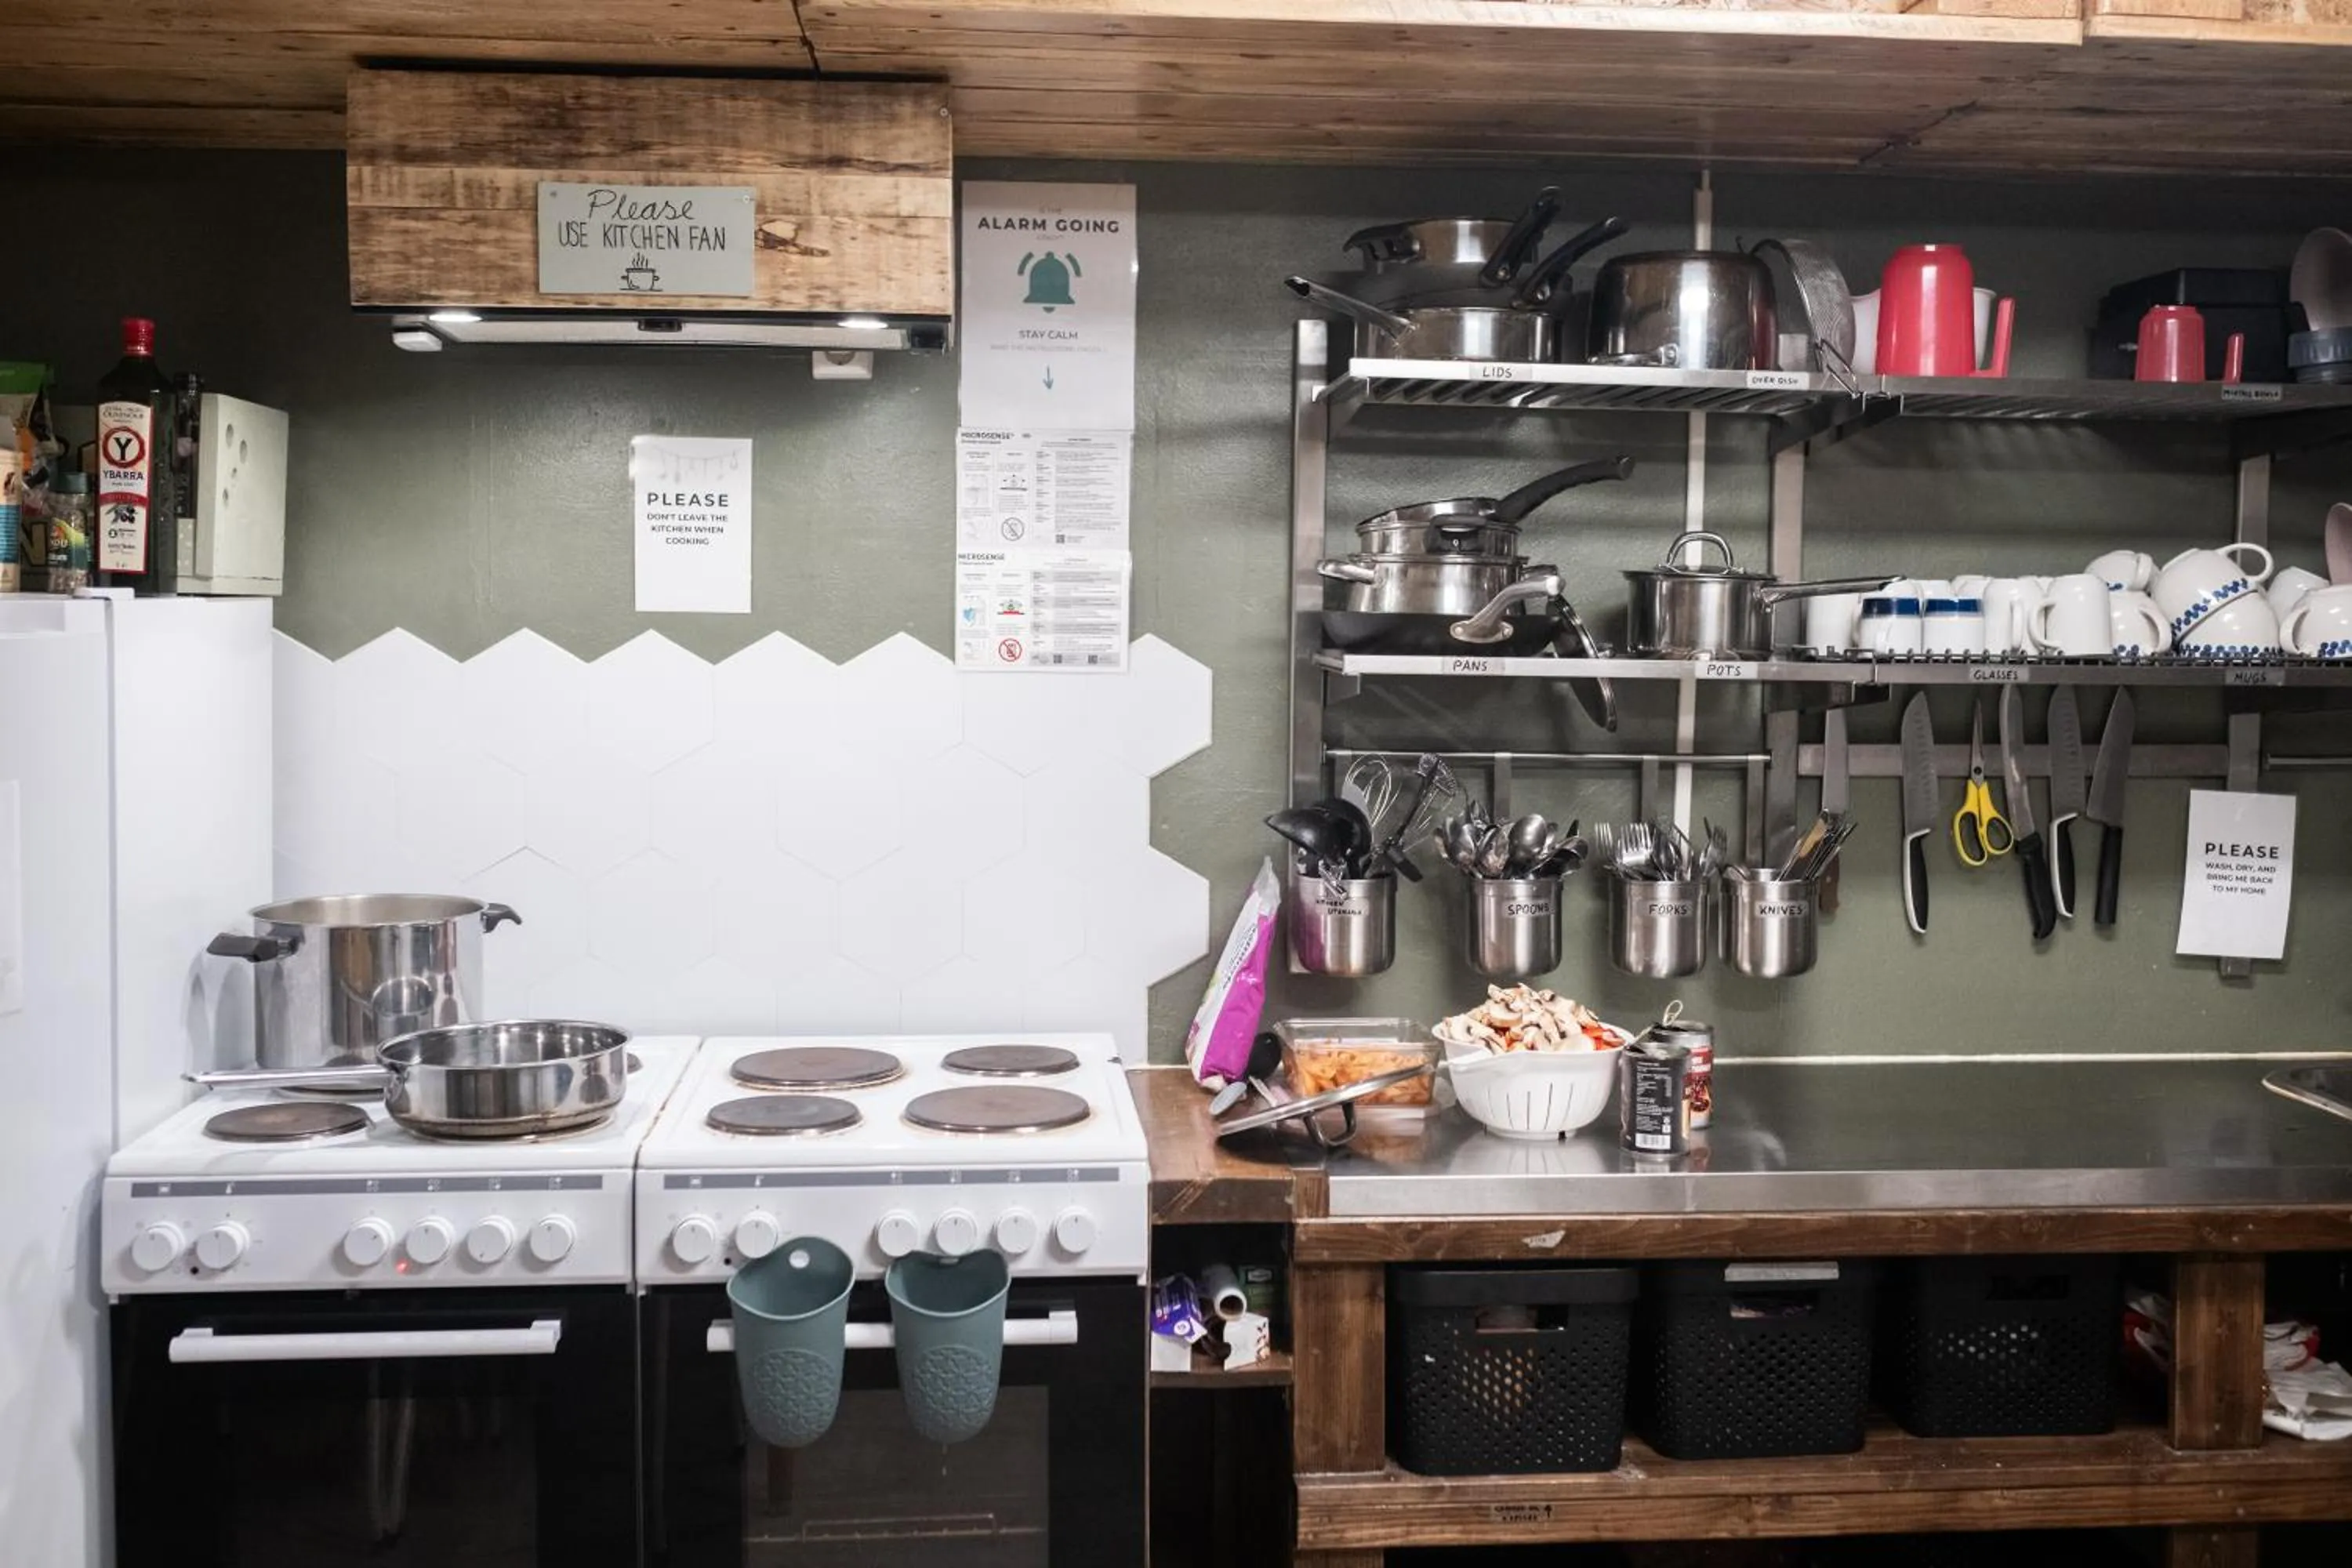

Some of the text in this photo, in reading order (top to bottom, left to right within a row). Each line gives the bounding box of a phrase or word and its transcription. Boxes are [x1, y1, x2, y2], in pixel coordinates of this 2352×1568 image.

[587, 189, 695, 220] Please
[978, 217, 1120, 233] ALARM GOING
[558, 220, 725, 251] USE KITCHEN FAN
[1018, 330, 1079, 339] STAY CALM
[1483, 367, 1512, 379] LIDS
[114, 437, 132, 461] Y
[103, 470, 143, 481] YBARRA
[648, 492, 728, 507] PLEASE
[647, 514, 676, 522] DON'T
[678, 514, 707, 522] LEAVE
[651, 524, 724, 534] KITCHEN WHEN
[666, 537, 710, 546] COOKING
[1453, 661, 1487, 672] PANS
[1706, 665, 1741, 677] POTS
[1973, 670, 2018, 681] GLASSES
[2234, 671, 2267, 682] MUGS
[2205, 842, 2280, 859] PLEASE
[1508, 902, 1551, 916] SPOONS
[1649, 904, 1687, 915] FORKS
[1759, 905, 1803, 916] KNIVES
